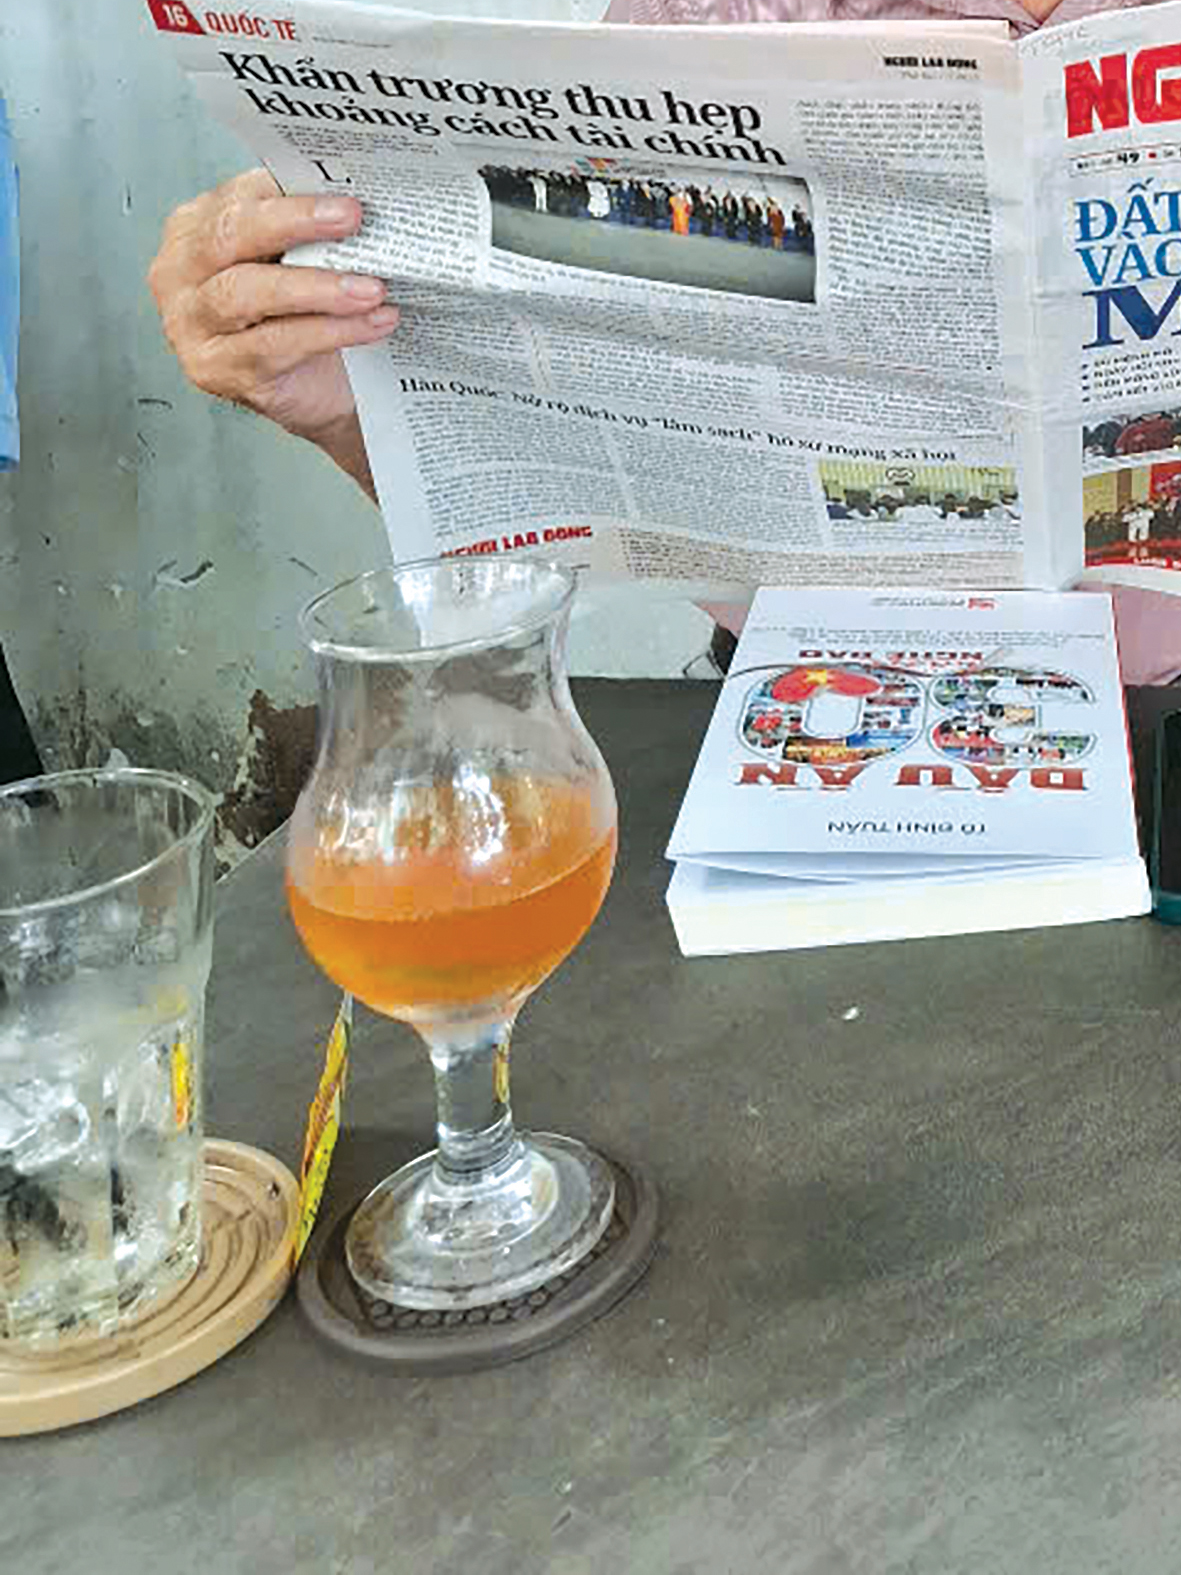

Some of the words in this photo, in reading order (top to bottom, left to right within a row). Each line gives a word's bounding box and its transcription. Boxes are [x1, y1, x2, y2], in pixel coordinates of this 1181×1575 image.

[162, 4, 188, 27] 16
[204, 9, 271, 40] QUỐC
[218, 50, 366, 95] Khẩn
[366, 69, 560, 119] trương
[564, 83, 655, 122] thu
[660, 89, 762, 140] hẹp
[240, 86, 441, 137] khoảng
[444, 111, 562, 143] cách
[566, 122, 637, 151] tài
[644, 129, 788, 166] chính
[1117, 153, 1140, 165] 49
[736, 762, 868, 792] ẤN
[894, 763, 1088, 793] DẤU
